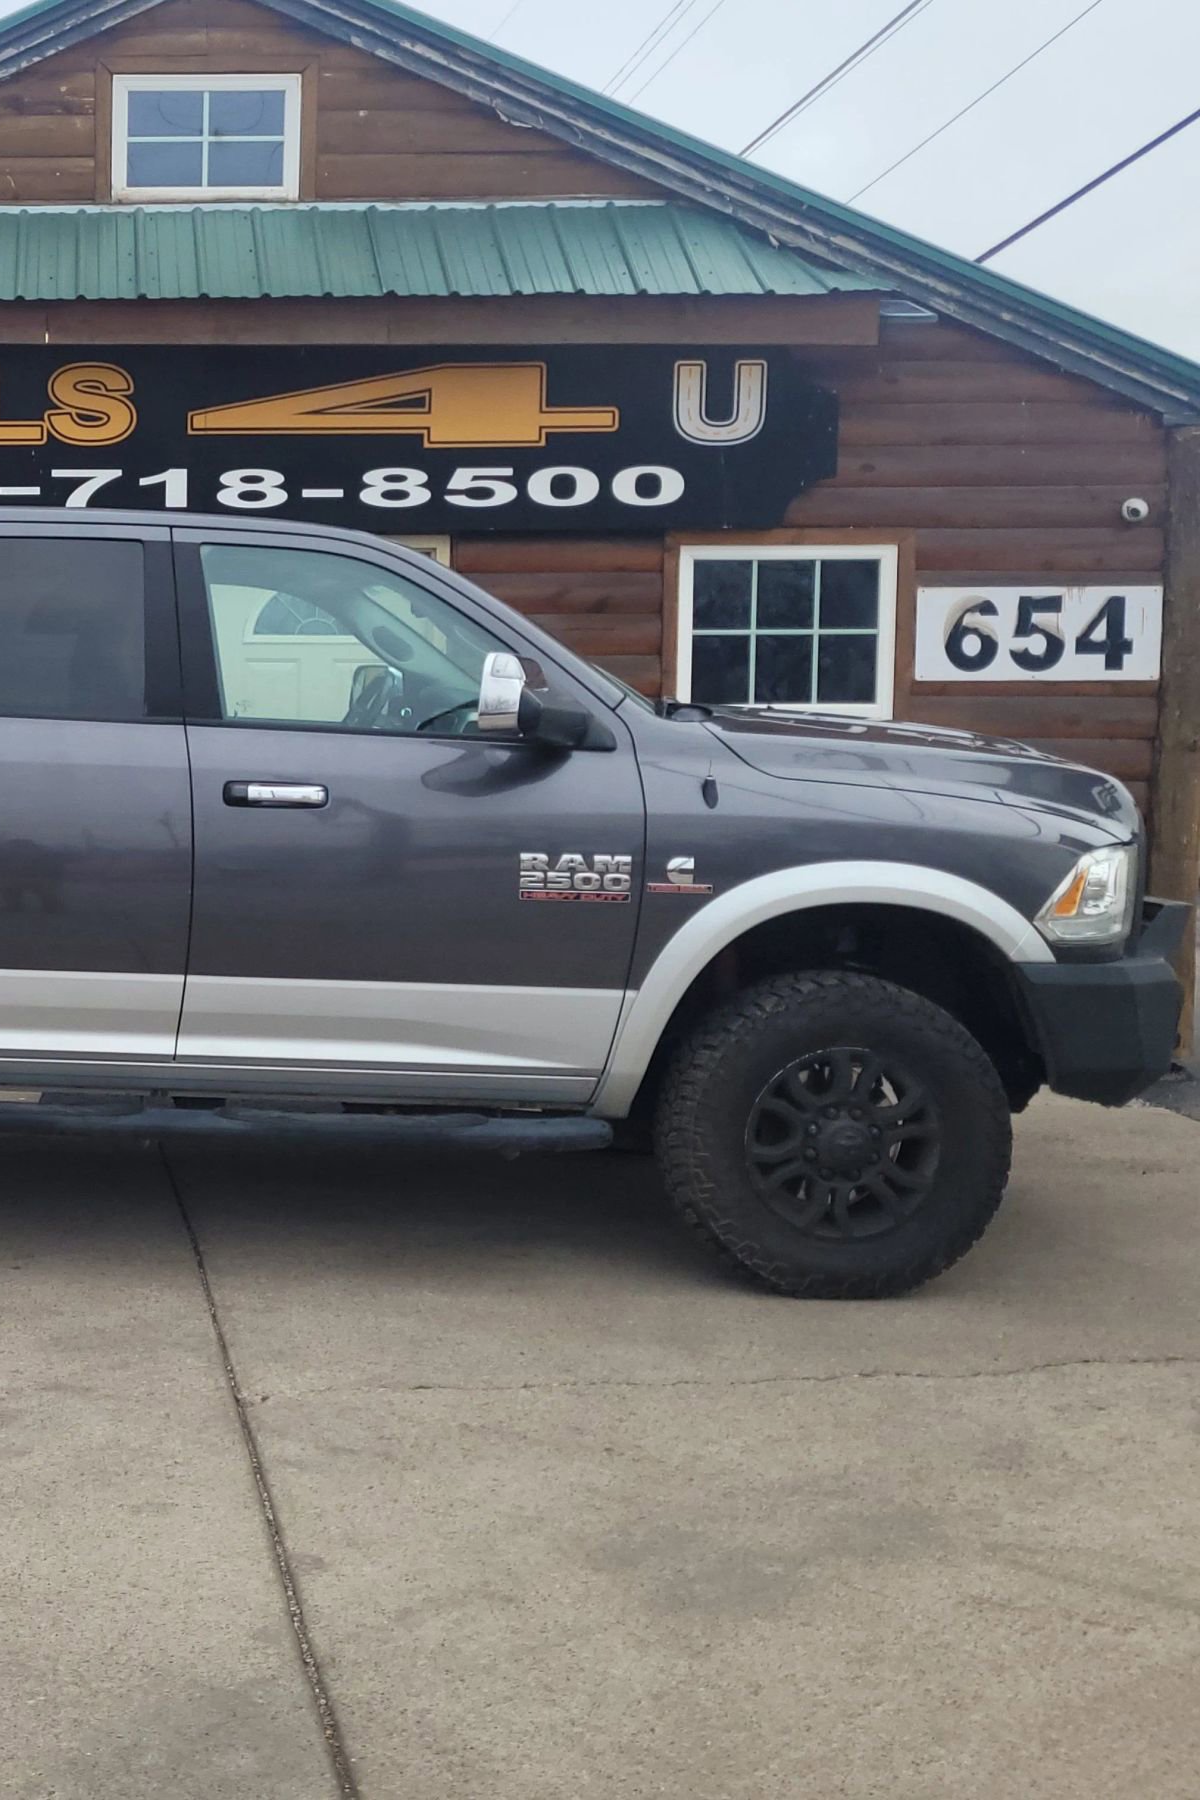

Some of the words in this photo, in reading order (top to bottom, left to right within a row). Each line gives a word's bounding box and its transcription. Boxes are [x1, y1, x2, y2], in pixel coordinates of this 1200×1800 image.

[187, 361, 620, 448] 4
[673, 360, 768, 446] U
[944, 595, 1134, 672] 654
[519, 853, 632, 873] RAM
[519, 872, 632, 891] 2500
